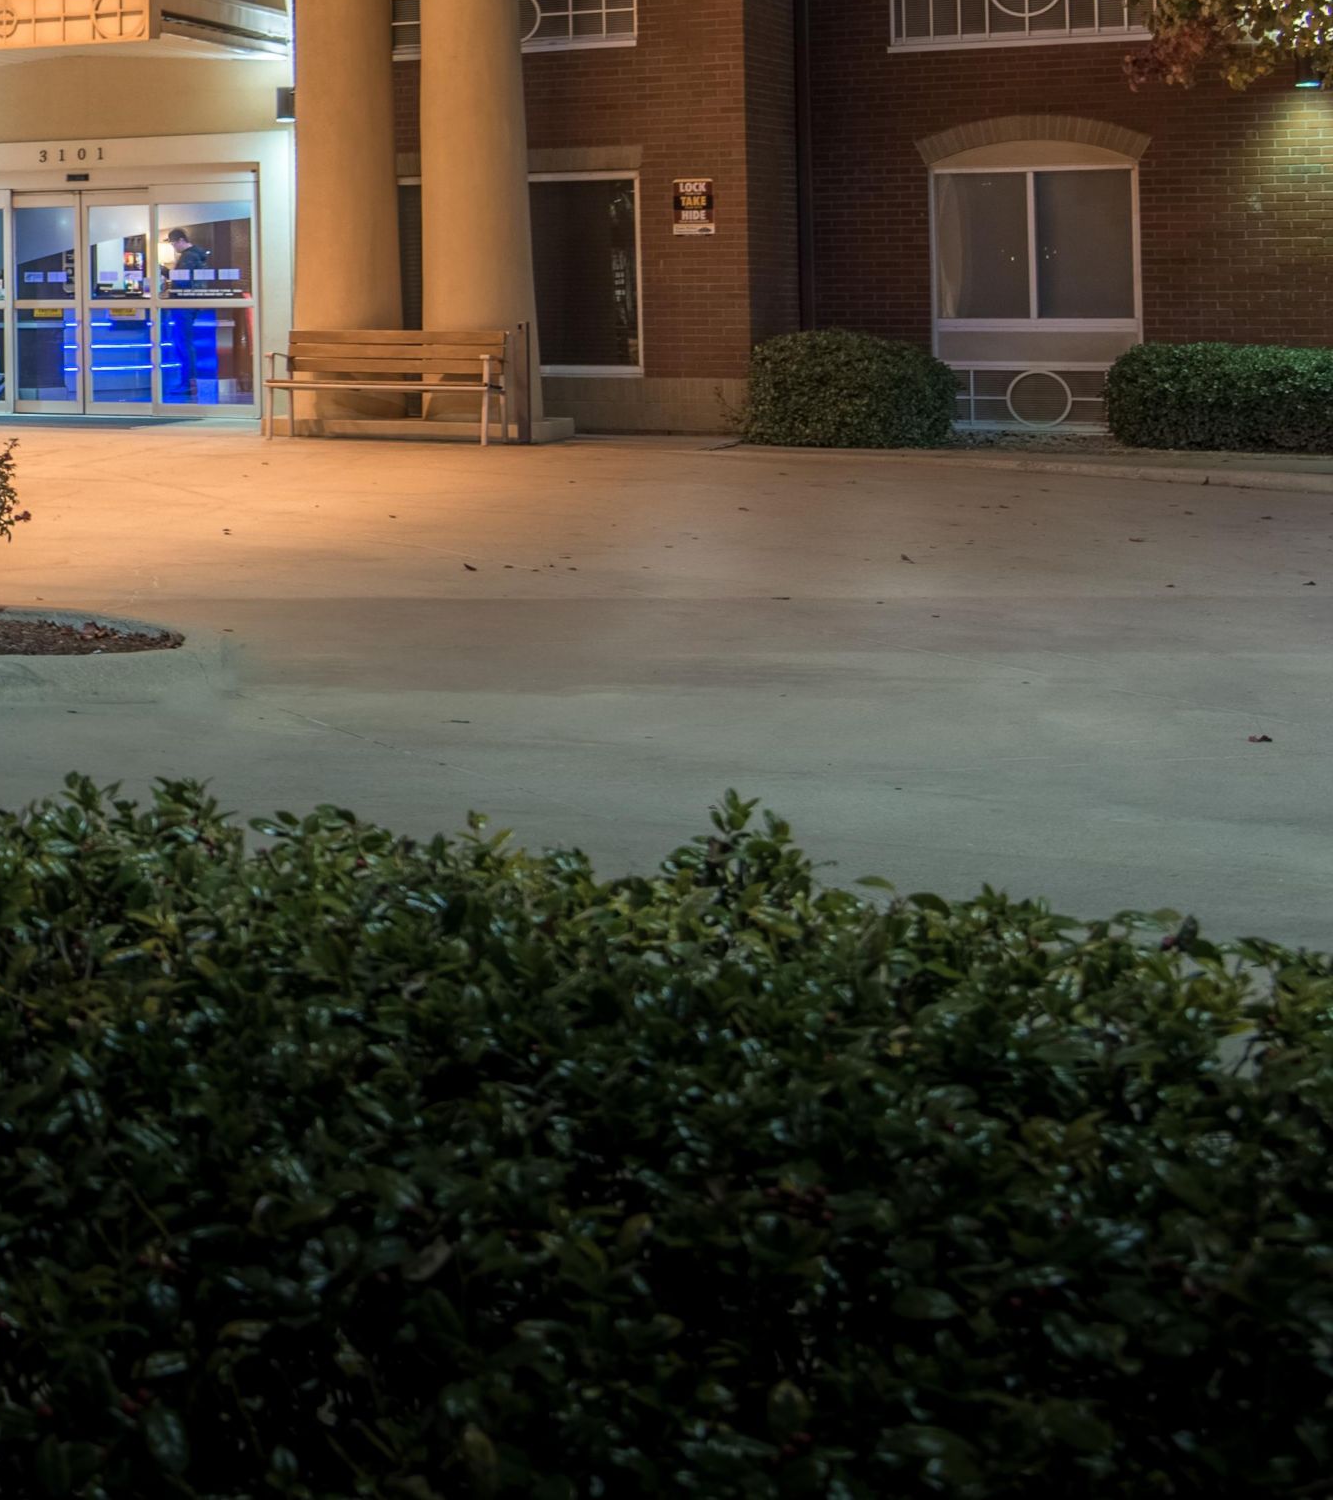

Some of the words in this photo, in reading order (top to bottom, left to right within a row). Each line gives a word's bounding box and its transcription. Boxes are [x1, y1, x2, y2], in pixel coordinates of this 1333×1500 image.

[39, 147, 104, 163] 3101
[679, 182, 707, 192] LOCK
[680, 196, 707, 206] TAKE
[681, 210, 707, 220] HIDE
